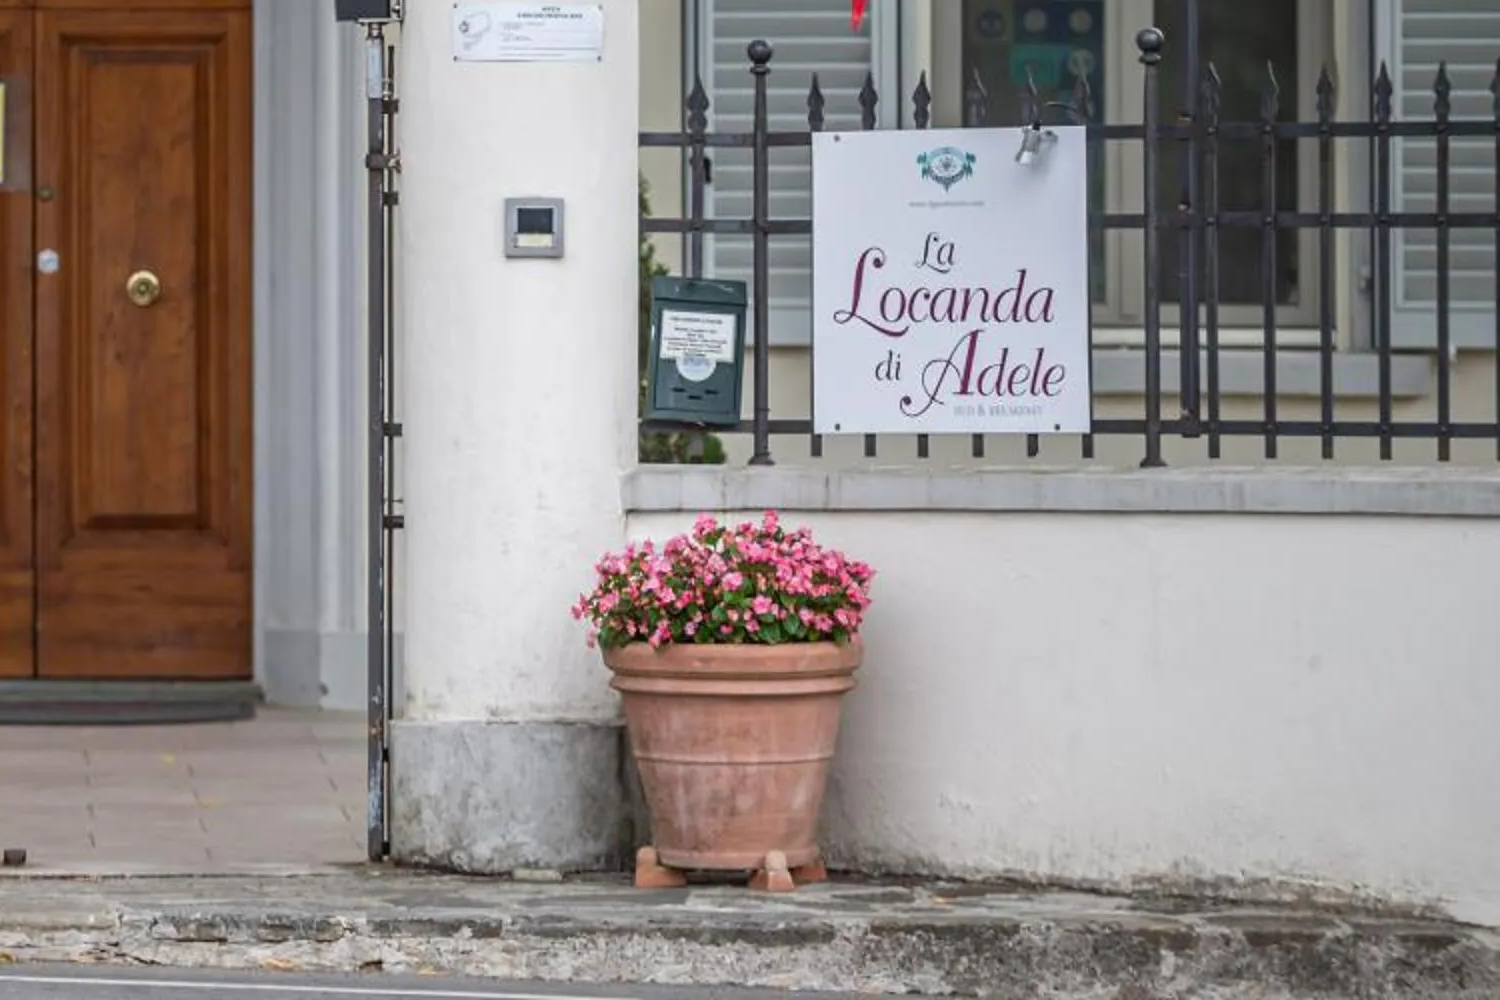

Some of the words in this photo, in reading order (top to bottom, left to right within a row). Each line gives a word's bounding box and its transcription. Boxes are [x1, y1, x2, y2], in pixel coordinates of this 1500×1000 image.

[833, 246, 1055, 337] Locanda
[915, 231, 956, 274] La
[875, 350, 901, 381] di
[899, 329, 1066, 417] Adele
